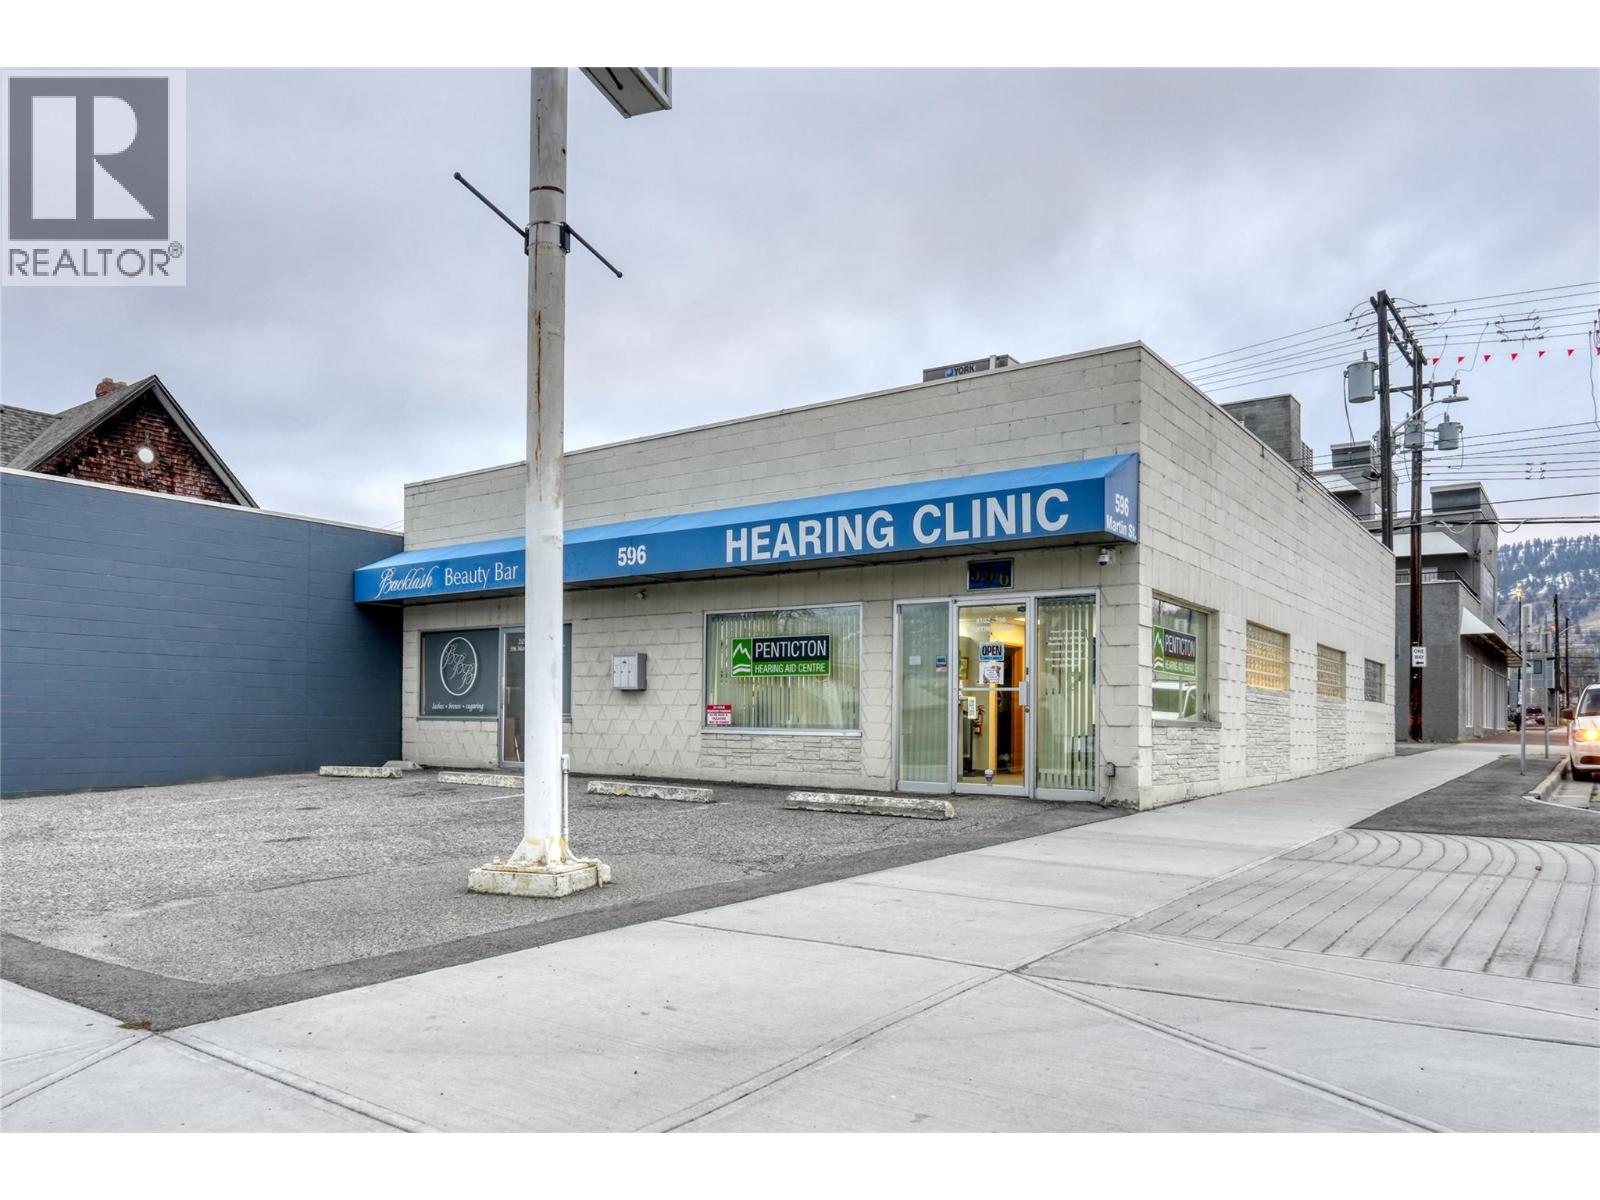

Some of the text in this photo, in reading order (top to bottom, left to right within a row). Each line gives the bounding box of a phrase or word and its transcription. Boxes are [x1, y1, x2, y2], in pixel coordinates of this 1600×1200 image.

[954, 364, 975, 376] YORK
[1115, 493, 1130, 518] 596
[725, 488, 1069, 562] HEARING CLINIC
[1106, 513, 1128, 536] Martin
[617, 544, 648, 567] 596
[374, 561, 519, 600] Backlash Beauty Bar
[755, 640, 827, 658] PENTICTON
[982, 645, 1002, 656] OPEN
[1165, 634, 1195, 657] PENTICTON
[754, 662, 826, 674] HEARING AID CENTRE
